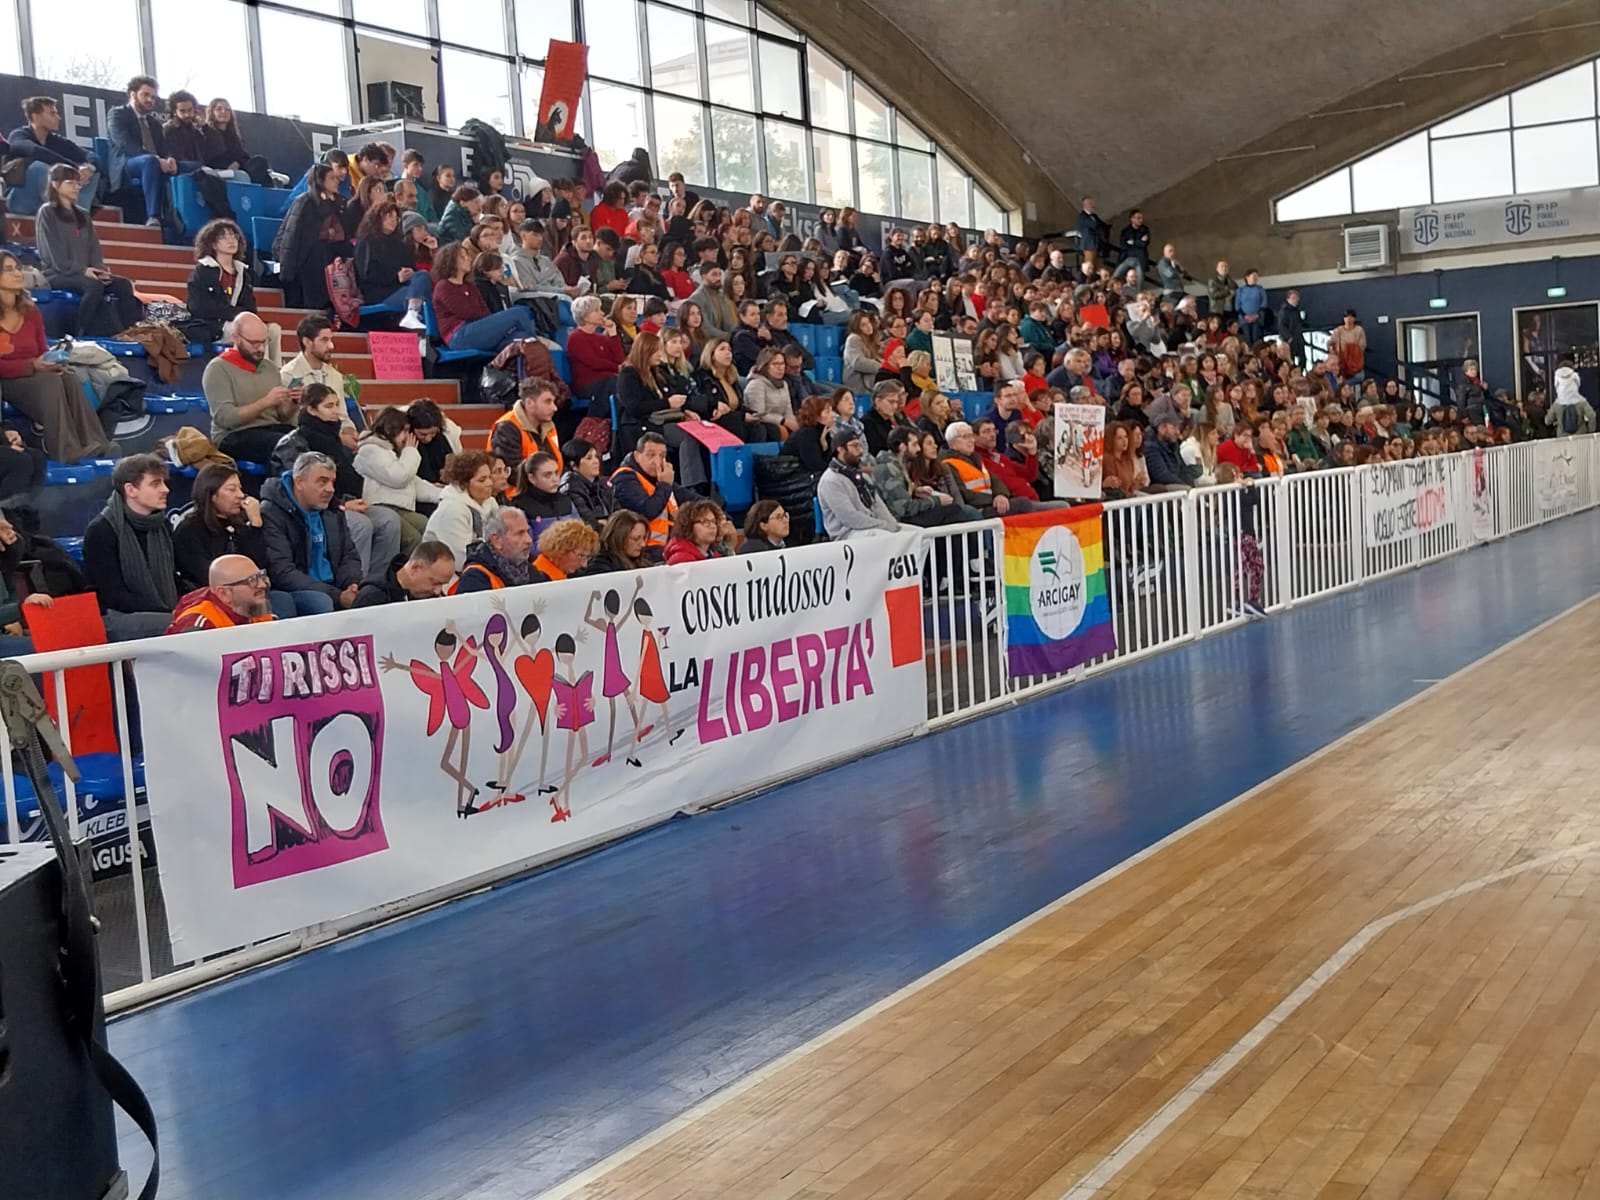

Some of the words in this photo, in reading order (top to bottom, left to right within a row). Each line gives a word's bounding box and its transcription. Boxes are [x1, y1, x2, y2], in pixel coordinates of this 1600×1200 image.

[1444, 212, 1465, 221] FIP
[1537, 202, 1558, 211] FIP
[1373, 507, 1395, 542] VOGLIO
[888, 553, 919, 581] CGIL
[681, 578, 740, 635] cosa
[747, 554, 836, 623] indosso
[1037, 582, 1081, 608] ARCIGAY
[229, 654, 273, 705] TI
[281, 640, 375, 700] RISSI
[669, 657, 700, 693] LA
[230, 711, 376, 864] NO
